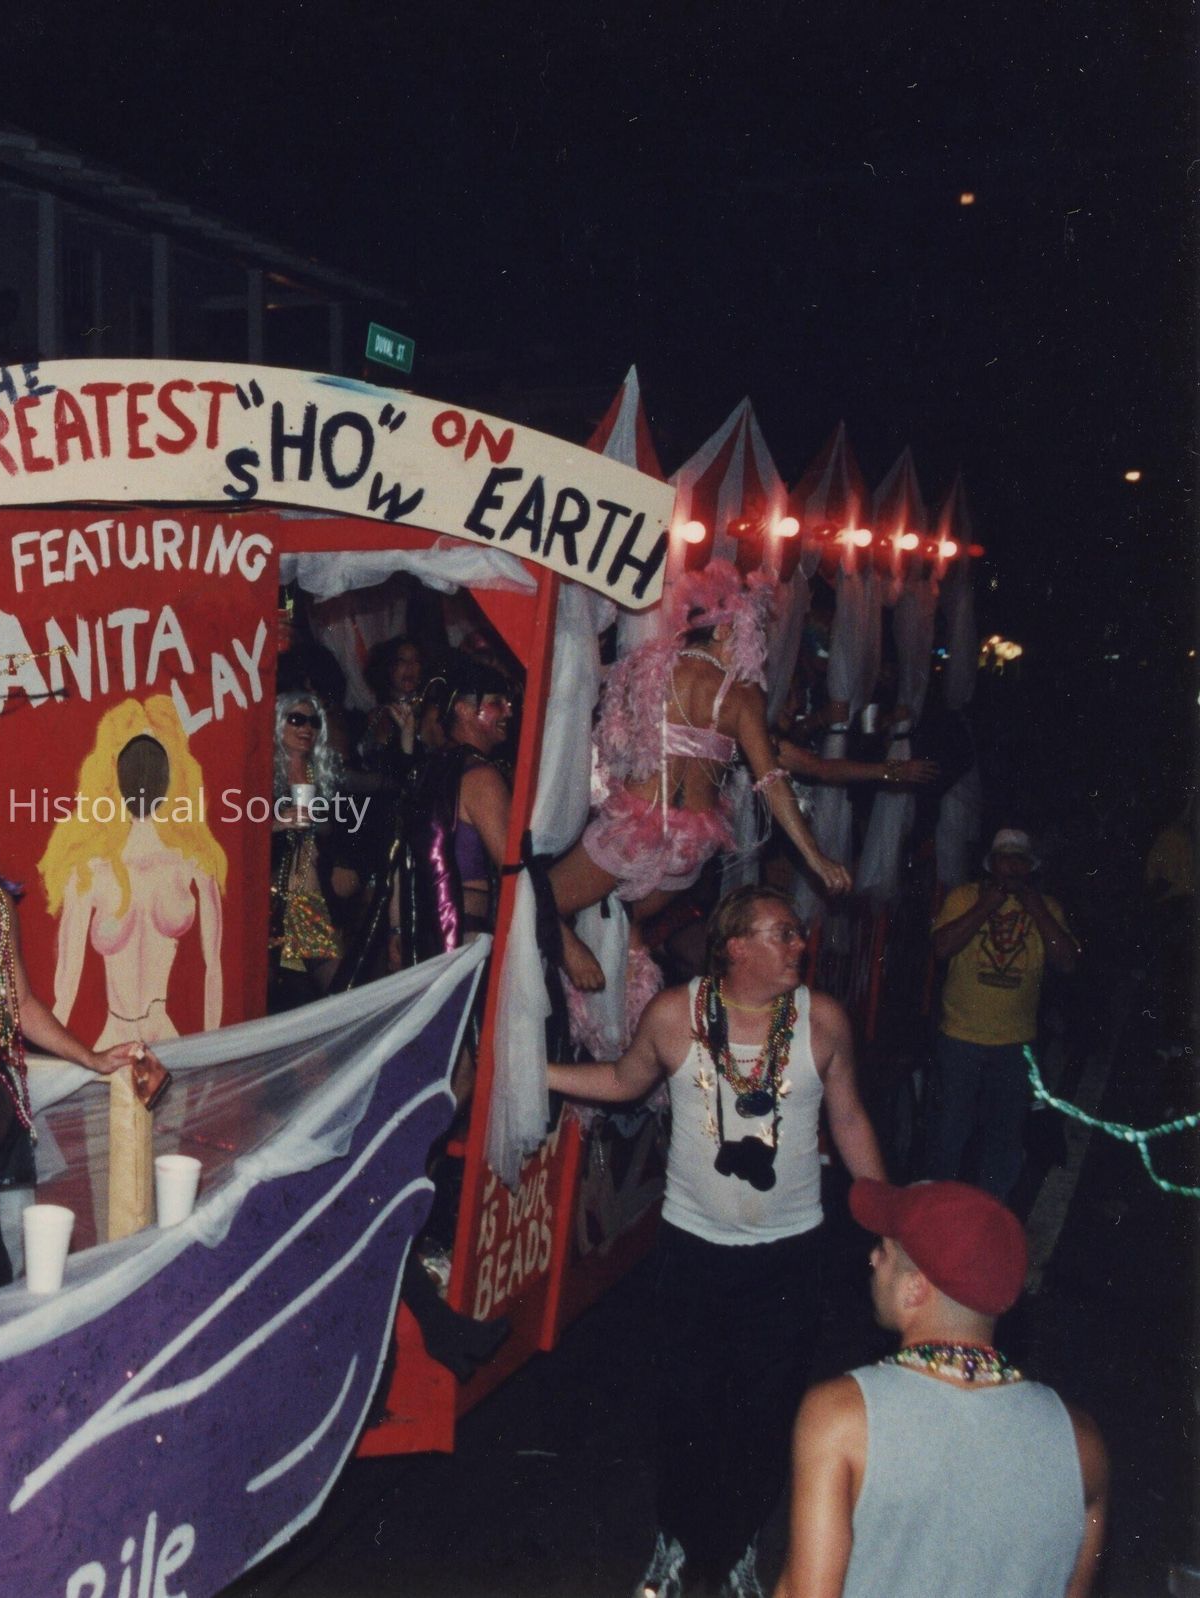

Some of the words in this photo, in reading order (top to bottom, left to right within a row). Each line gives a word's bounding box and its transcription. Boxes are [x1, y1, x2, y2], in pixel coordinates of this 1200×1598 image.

[431, 409, 515, 464] ON
[11, 518, 274, 593] FEATURING
[463, 466, 669, 600] EARTH
[169, 616, 268, 737] LAY
[506, 1167, 549, 1235] YOUR
[473, 1203, 554, 1323] BEADS
